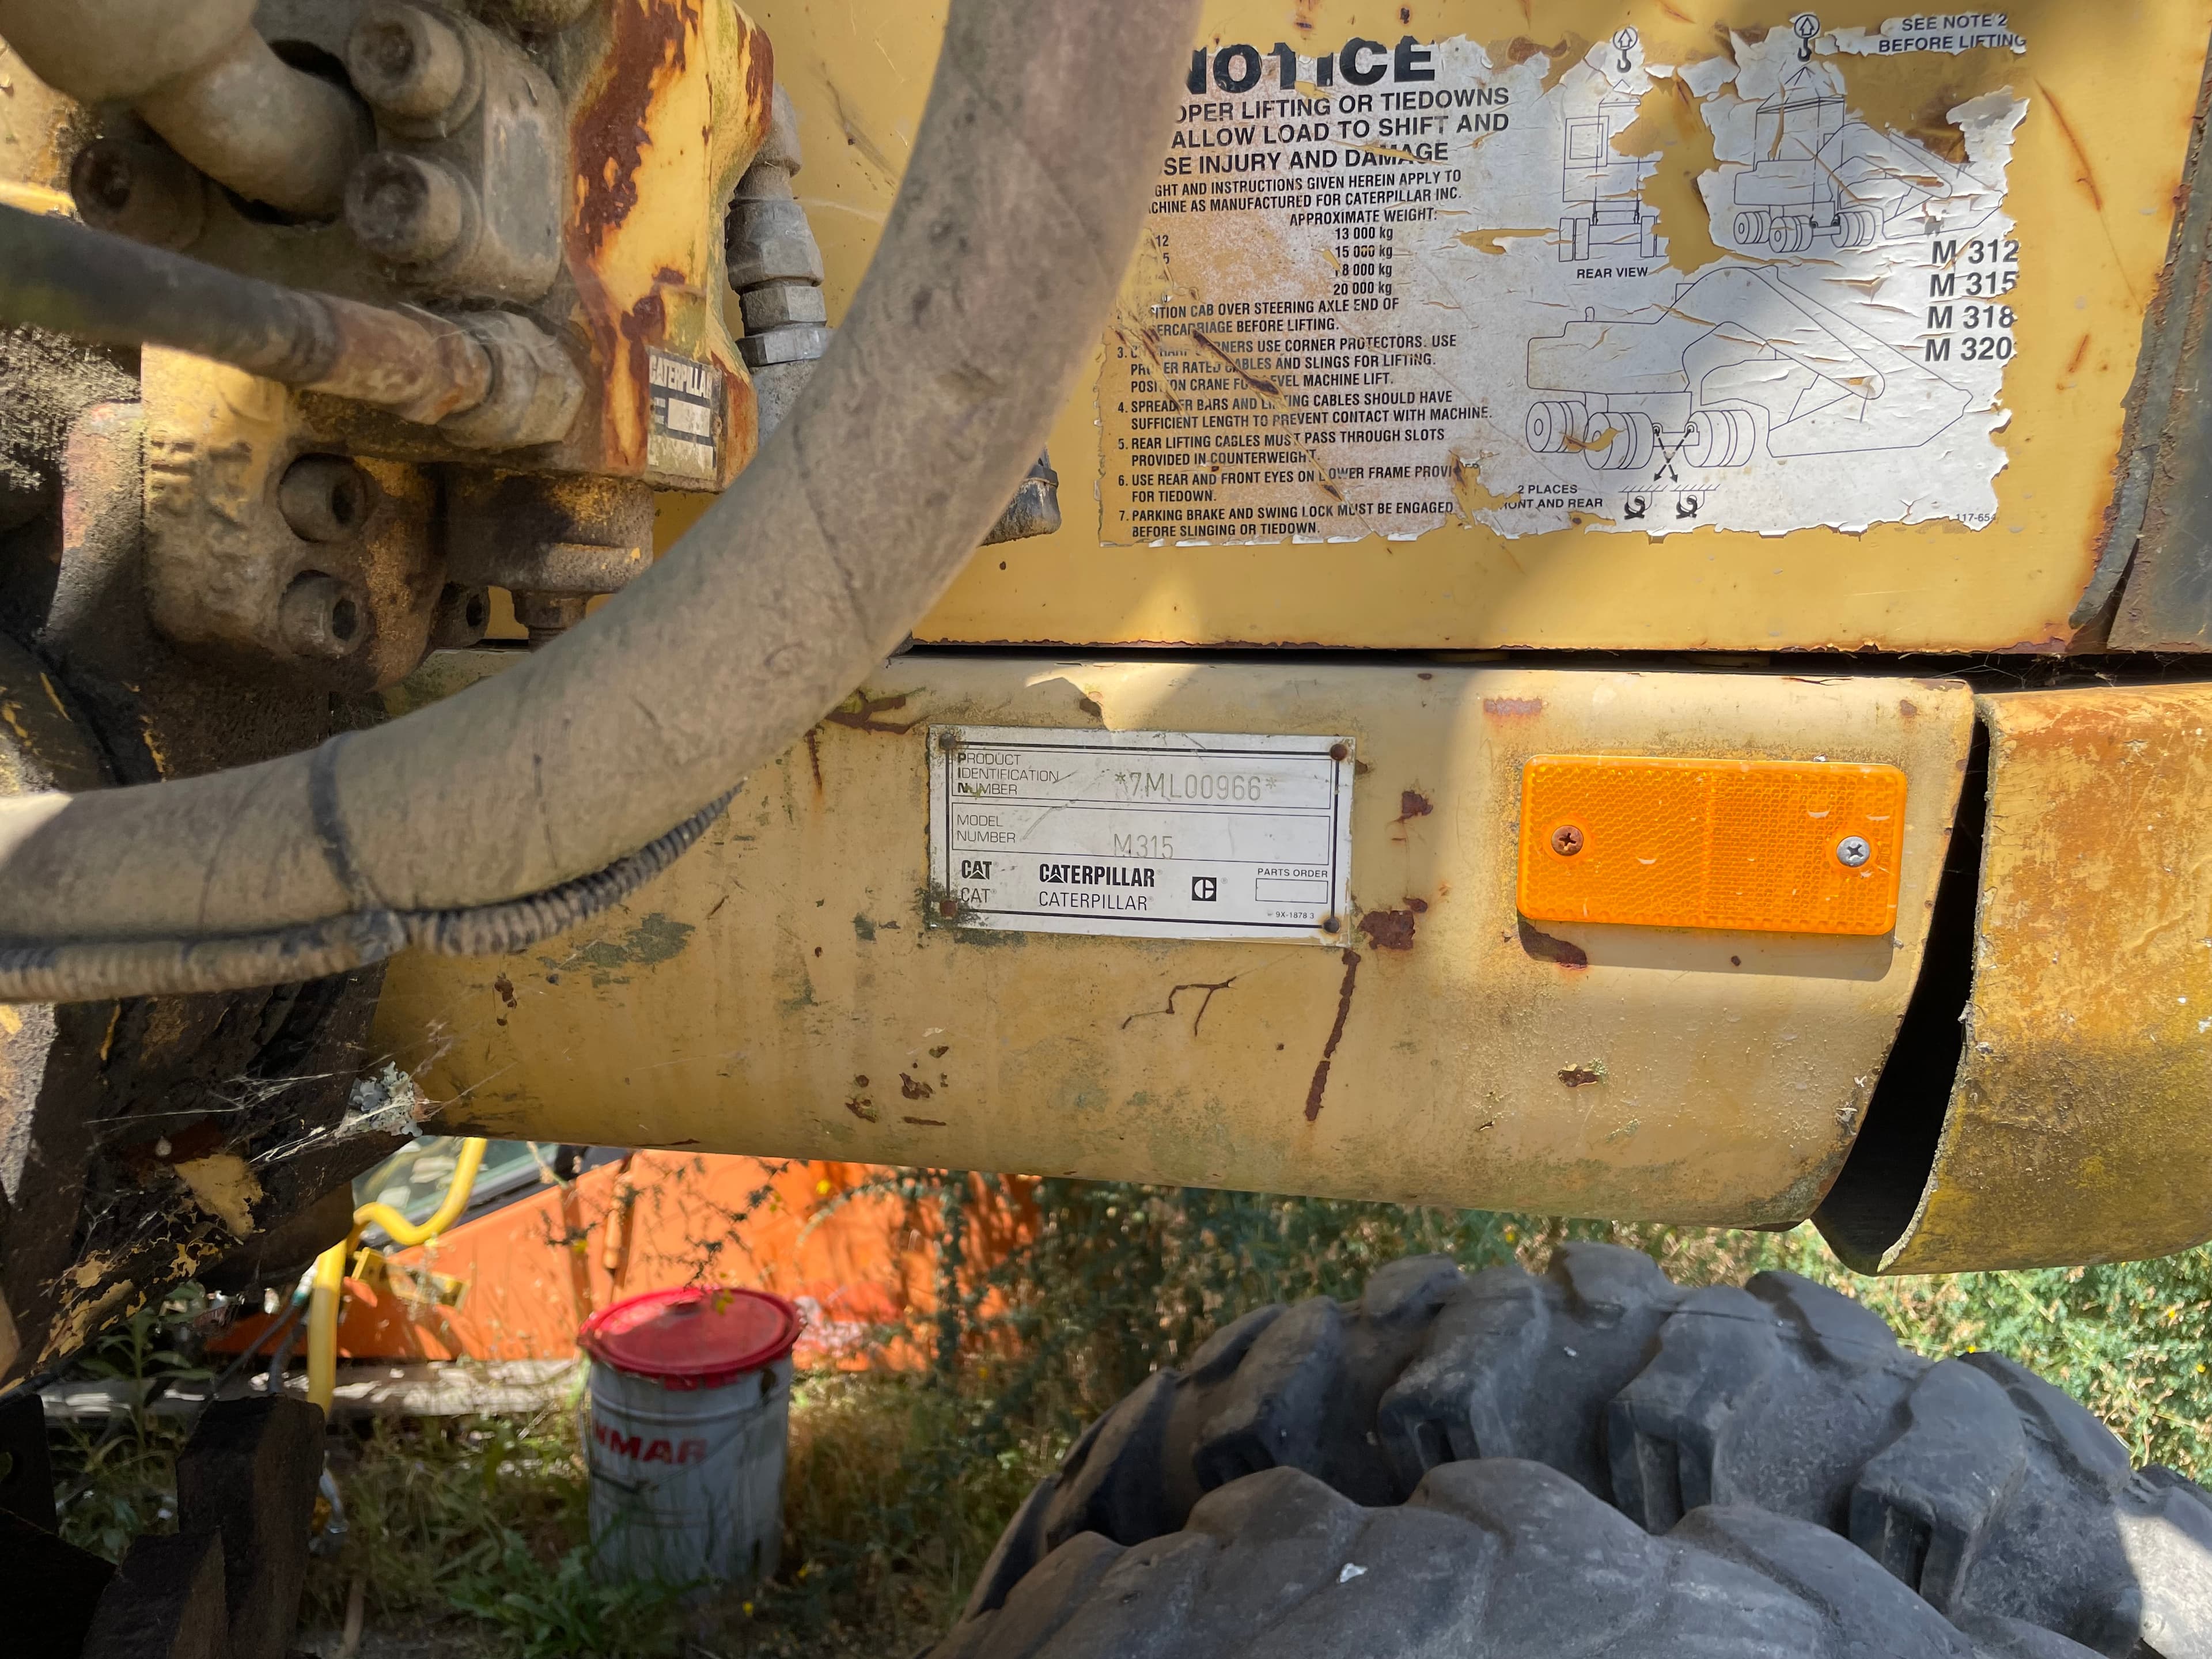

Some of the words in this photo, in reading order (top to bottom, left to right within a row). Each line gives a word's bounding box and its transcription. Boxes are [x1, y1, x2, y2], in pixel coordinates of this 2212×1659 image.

[1902, 17, 1937, 31] SEE
[1944, 14, 1991, 29] NOTE
[1998, 14, 2007, 26] 2
[1879, 36, 1953, 52] BEFORE
[1960, 35, 2027, 49] LIFTING
[1176, 103, 1233, 123] OPER
[1243, 99, 1330, 119] LIFTING
[1339, 94, 1372, 113] OR
[1381, 88, 1509, 111] TIEDOWNS
[1171, 124, 1255, 149] ALLOW
[1264, 123, 1329, 143] LOAD
[1338, 120, 1369, 139] TO
[1380, 116, 1448, 137] SHIFT
[1456, 113, 1509, 133] AND
[1164, 157, 1191, 176] SE
[1200, 152, 1281, 173] INJURY
[1289, 149, 1337, 169] AND
[1346, 143, 1448, 167] DAMAGE
[1155, 184, 1178, 197] GHT
[1182, 183, 1207, 195] AND
[1211, 177, 1302, 194] INSTRUCTIONS
[1308, 176, 1343, 190] GIVEN
[1349, 174, 1395, 188] HEREIN
[1399, 171, 1440, 185] APPLY
[1445, 169, 1461, 183] TO
[1149, 200, 1187, 214] CHINE
[1191, 199, 1205, 212] AS
[1211, 195, 1311, 211] MANUFACTURED
[1316, 193, 1340, 206] FOR
[1346, 189, 1431, 205] CATERPILLAR
[1435, 187, 1461, 200] INC.
[1290, 210, 1379, 226] APPROXIMATE
[1384, 207, 1437, 222] WEIGHT:
[1156, 234, 1169, 247] 12
[1335, 228, 1349, 240] 13
[1354, 227, 1375, 239] 000
[1379, 227, 1393, 240] kg
[1335, 246, 1349, 258] 15
[1354, 245, 1375, 257] 000
[1379, 245, 1393, 259] kg
[1932, 240, 1956, 264] M
[1968, 238, 2020, 264] 312
[1353, 263, 1374, 276] 000
[1379, 263, 1392, 277] kg
[1577, 268, 1612, 279] REAR
[1616, 267, 1648, 277] VIEW
[1334, 283, 1348, 296] 20
[1353, 282, 1374, 294] 000
[1378, 282, 1392, 295] kg
[1930, 273, 1955, 297] M
[1966, 271, 2020, 296] 315
[1155, 306, 1186, 319] ITION
[1191, 304, 1213, 317] CAB
[1218, 303, 1250, 315] OVER
[1255, 301, 1314, 315] STEERING
[1319, 300, 1349, 312] AXLE
[1354, 299, 1378, 311] END
[1383, 298, 1399, 310] OF
[1927, 306, 1952, 329] M
[1963, 305, 2014, 329] 318
[1237, 320, 1283, 332] BEFORE
[1288, 317, 1339, 331] LIFTING.
[1118, 347, 1127, 358] 3.
[1258, 340, 1281, 352] USE
[1285, 338, 1335, 352] CORNER
[1340, 335, 1427, 350] PROTECTORS.
[1432, 335, 1457, 347] USE
[1925, 338, 1950, 361] M
[1960, 336, 2012, 361] 320
[1275, 357, 1300, 370] AND
[1305, 355, 1350, 369] SLINGS
[1354, 355, 1378, 368] FOR
[1383, 353, 1436, 366] LIFTING.
[1131, 379, 1185, 393] POSION
[1190, 377, 1229, 391] CRANE
[1304, 373, 1359, 387] MACHINE
[1363, 372, 1393, 385] LIFT.
[1118, 402, 1128, 413] 4.
[1197, 398, 1228, 411] BARS
[1233, 397, 1257, 410] AND
[1313, 393, 1359, 407] CABLES
[1364, 392, 1415, 406] SHOULD
[1420, 391, 1452, 403] HAVE
[1131, 416, 1198, 430] SUFFICIENT
[1203, 415, 1248, 427] LENGTH
[1253, 415, 1267, 427] TO
[1272, 412, 1328, 426] PREVENT
[1332, 410, 1389, 423] CONTACT
[1393, 408, 1426, 422] WITH
[1430, 406, 1492, 421] MACHINE.
[1118, 438, 1128, 449] 5.
[1131, 438, 1161, 449] REAR
[1166, 435, 1210, 449] LIFTING
[1215, 435, 1260, 447] CABLES
[1264, 433, 1301, 446] MUST
[1305, 431, 1335, 444] PASS
[1340, 429, 1400, 443] THROUGH
[1405, 428, 1445, 441] SLOTS
[1132, 453, 1190, 466] PROVIDED
[1194, 453, 1206, 464] IN
[1118, 475, 1128, 486] 6.
[1132, 474, 1153, 486] USE
[1158, 474, 1188, 486] REAR
[1192, 473, 1217, 485] AND
[1221, 472, 1260, 484] FRONT
[1264, 471, 1293, 483] EYES
[1298, 470, 1314, 482] ON
[1319, 467, 1364, 482] LOWER
[1369, 466, 1410, 479] FRAME
[1132, 491, 1154, 502] FOR
[1158, 490, 1217, 502] TIEDOWN.
[1518, 484, 1524, 494] 2
[1528, 484, 1577, 494] PLACES
[1119, 510, 1128, 521] 7.
[1132, 509, 1182, 521] PARKING
[1187, 508, 1225, 521] BRAKE
[1229, 507, 1253, 519] AND
[1257, 506, 1297, 518] SWING
[1302, 505, 1333, 517] LOCK
[1338, 503, 1373, 516] MUST
[1377, 502, 1392, 514] BE
[1396, 502, 1453, 514] ENGAGED
[1538, 499, 1563, 508] AND
[1568, 498, 1603, 507] REAR
[1132, 525, 1176, 537] BEFORE
[1180, 524, 1235, 537] SLINGING
[1240, 524, 1256, 535] OR
[1260, 522, 1320, 535] TIEDOWN.
[957, 752, 1021, 766] PRODUCT
[958, 767, 1059, 782] IDENTIFICATION
[957, 782, 1017, 796] NUMBER
[957, 815, 1003, 827] MODEL
[957, 830, 1016, 844] NUMBER
[1114, 833, 1173, 859] M315
[1257, 868, 1290, 876] PARTS
[1293, 869, 1328, 877] ORDER
